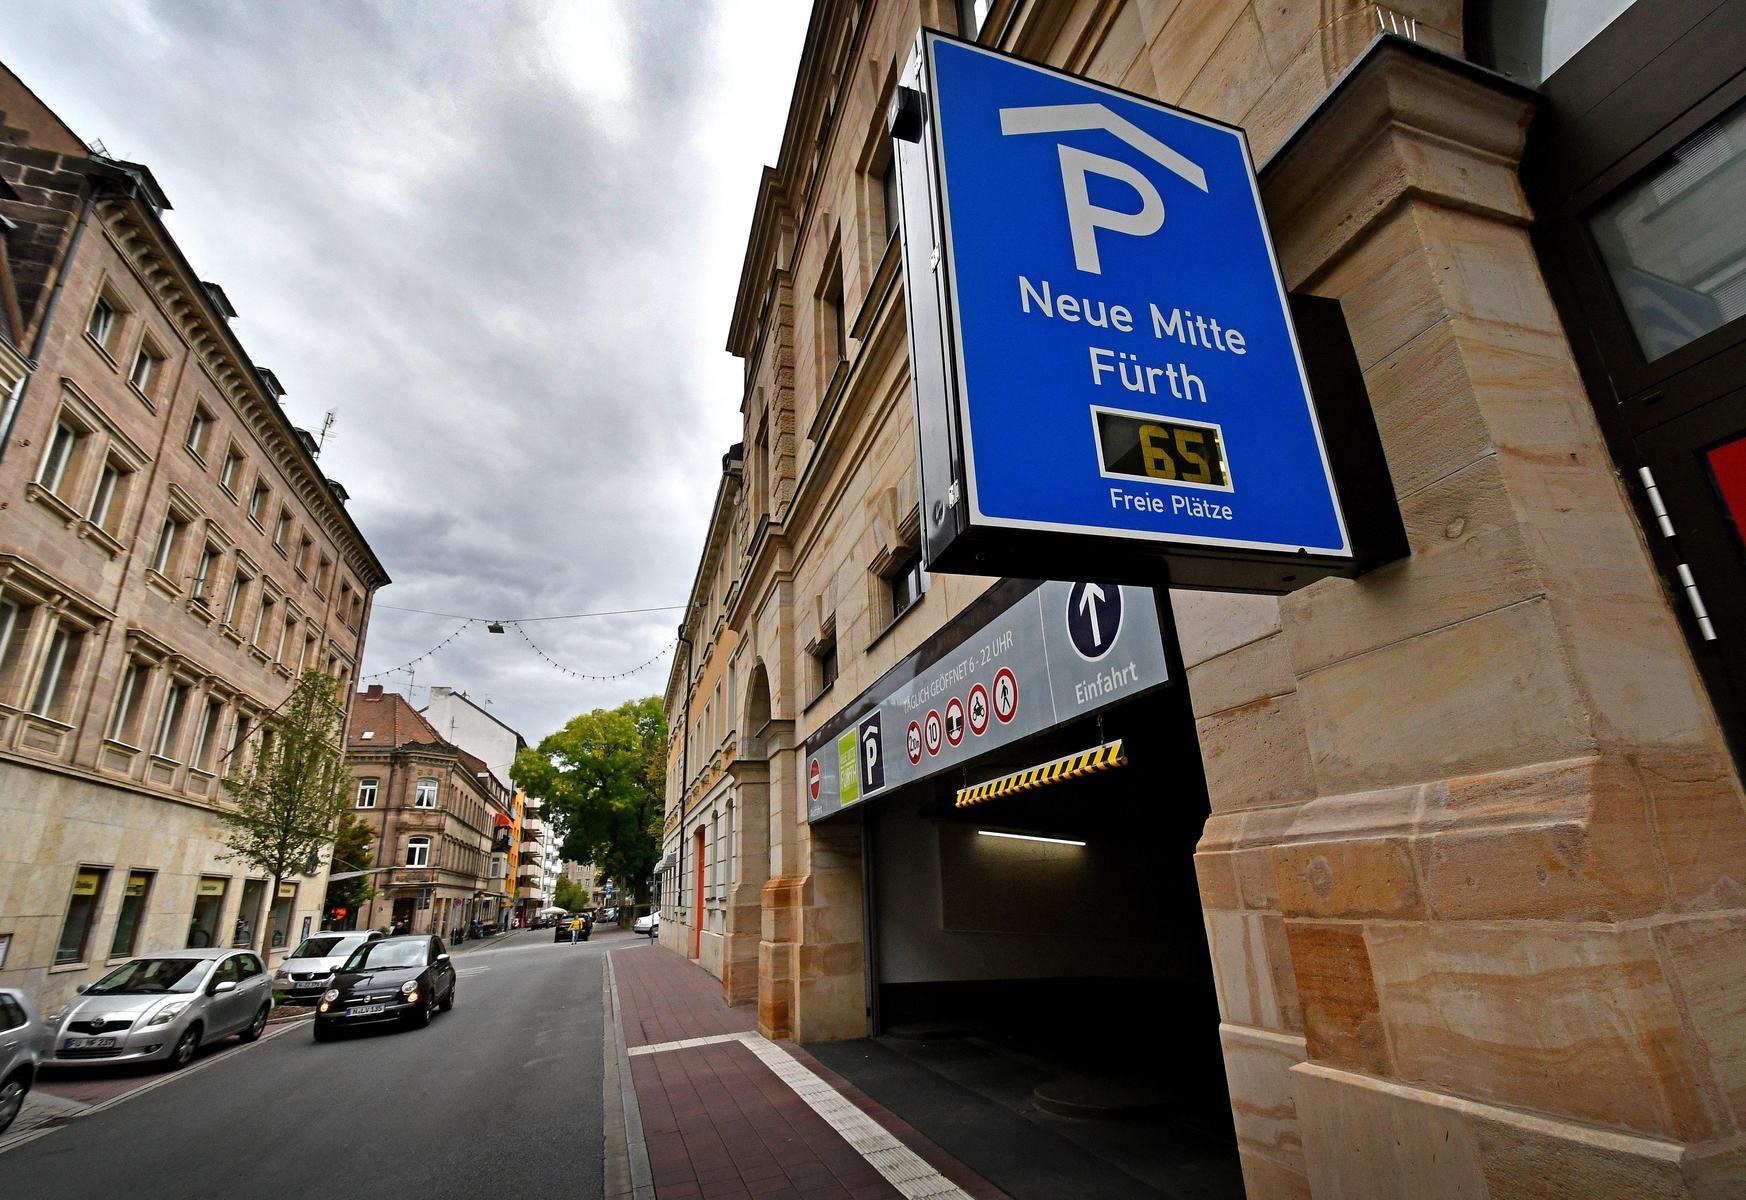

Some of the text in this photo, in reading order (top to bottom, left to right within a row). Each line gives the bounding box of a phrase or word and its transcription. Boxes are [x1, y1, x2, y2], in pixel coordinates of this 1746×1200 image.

[1057, 143, 1165, 275] P
[1018, 276, 1247, 356] Neue Mitte
[1089, 346, 1207, 403] Fürth
[1138, 424, 1212, 482] 65
[1110, 488, 1233, 521] Freie Plätze
[903, 686, 930, 715] TÄGLICH
[930, 660, 968, 697] GEÖFFNET
[968, 656, 975, 673] 6
[980, 646, 992, 666] 22
[992, 630, 1014, 657] UHR
[1074, 661, 1139, 705] Einfahrt
[865, 737, 877, 785] P
[928, 722, 938, 744] 10
